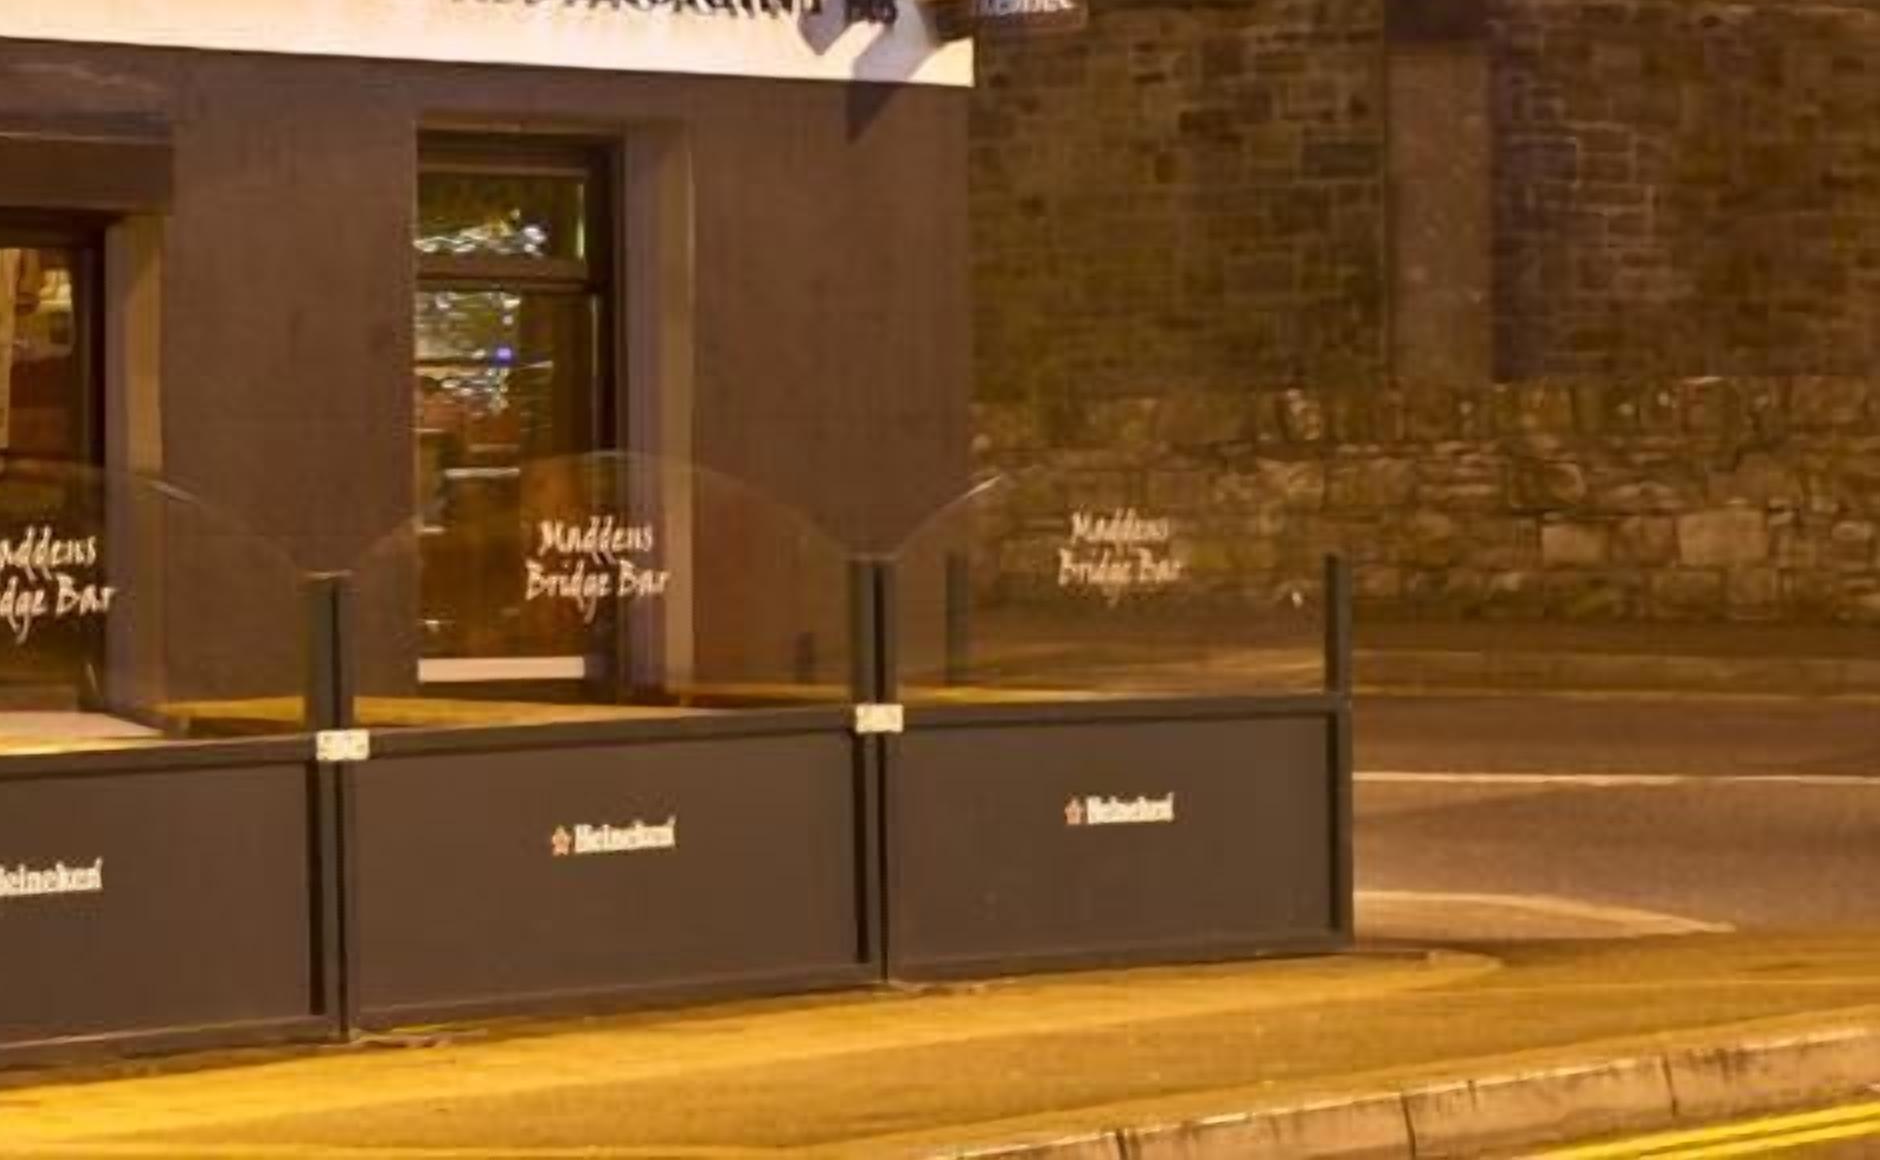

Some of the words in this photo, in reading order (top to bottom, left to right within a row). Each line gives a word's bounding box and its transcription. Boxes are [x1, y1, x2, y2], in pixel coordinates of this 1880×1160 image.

[538, 514, 653, 566] Maddens
[1070, 506, 1170, 556] Maddens
[55, 572, 115, 617] Bar
[525, 558, 611, 624] Bridge
[617, 558, 669, 597] Bar
[1058, 548, 1132, 608] Bridge
[1137, 546, 1183, 584] Bar
[1086, 792, 1174, 825] Heineken
[574, 816, 676, 854] Heineken
